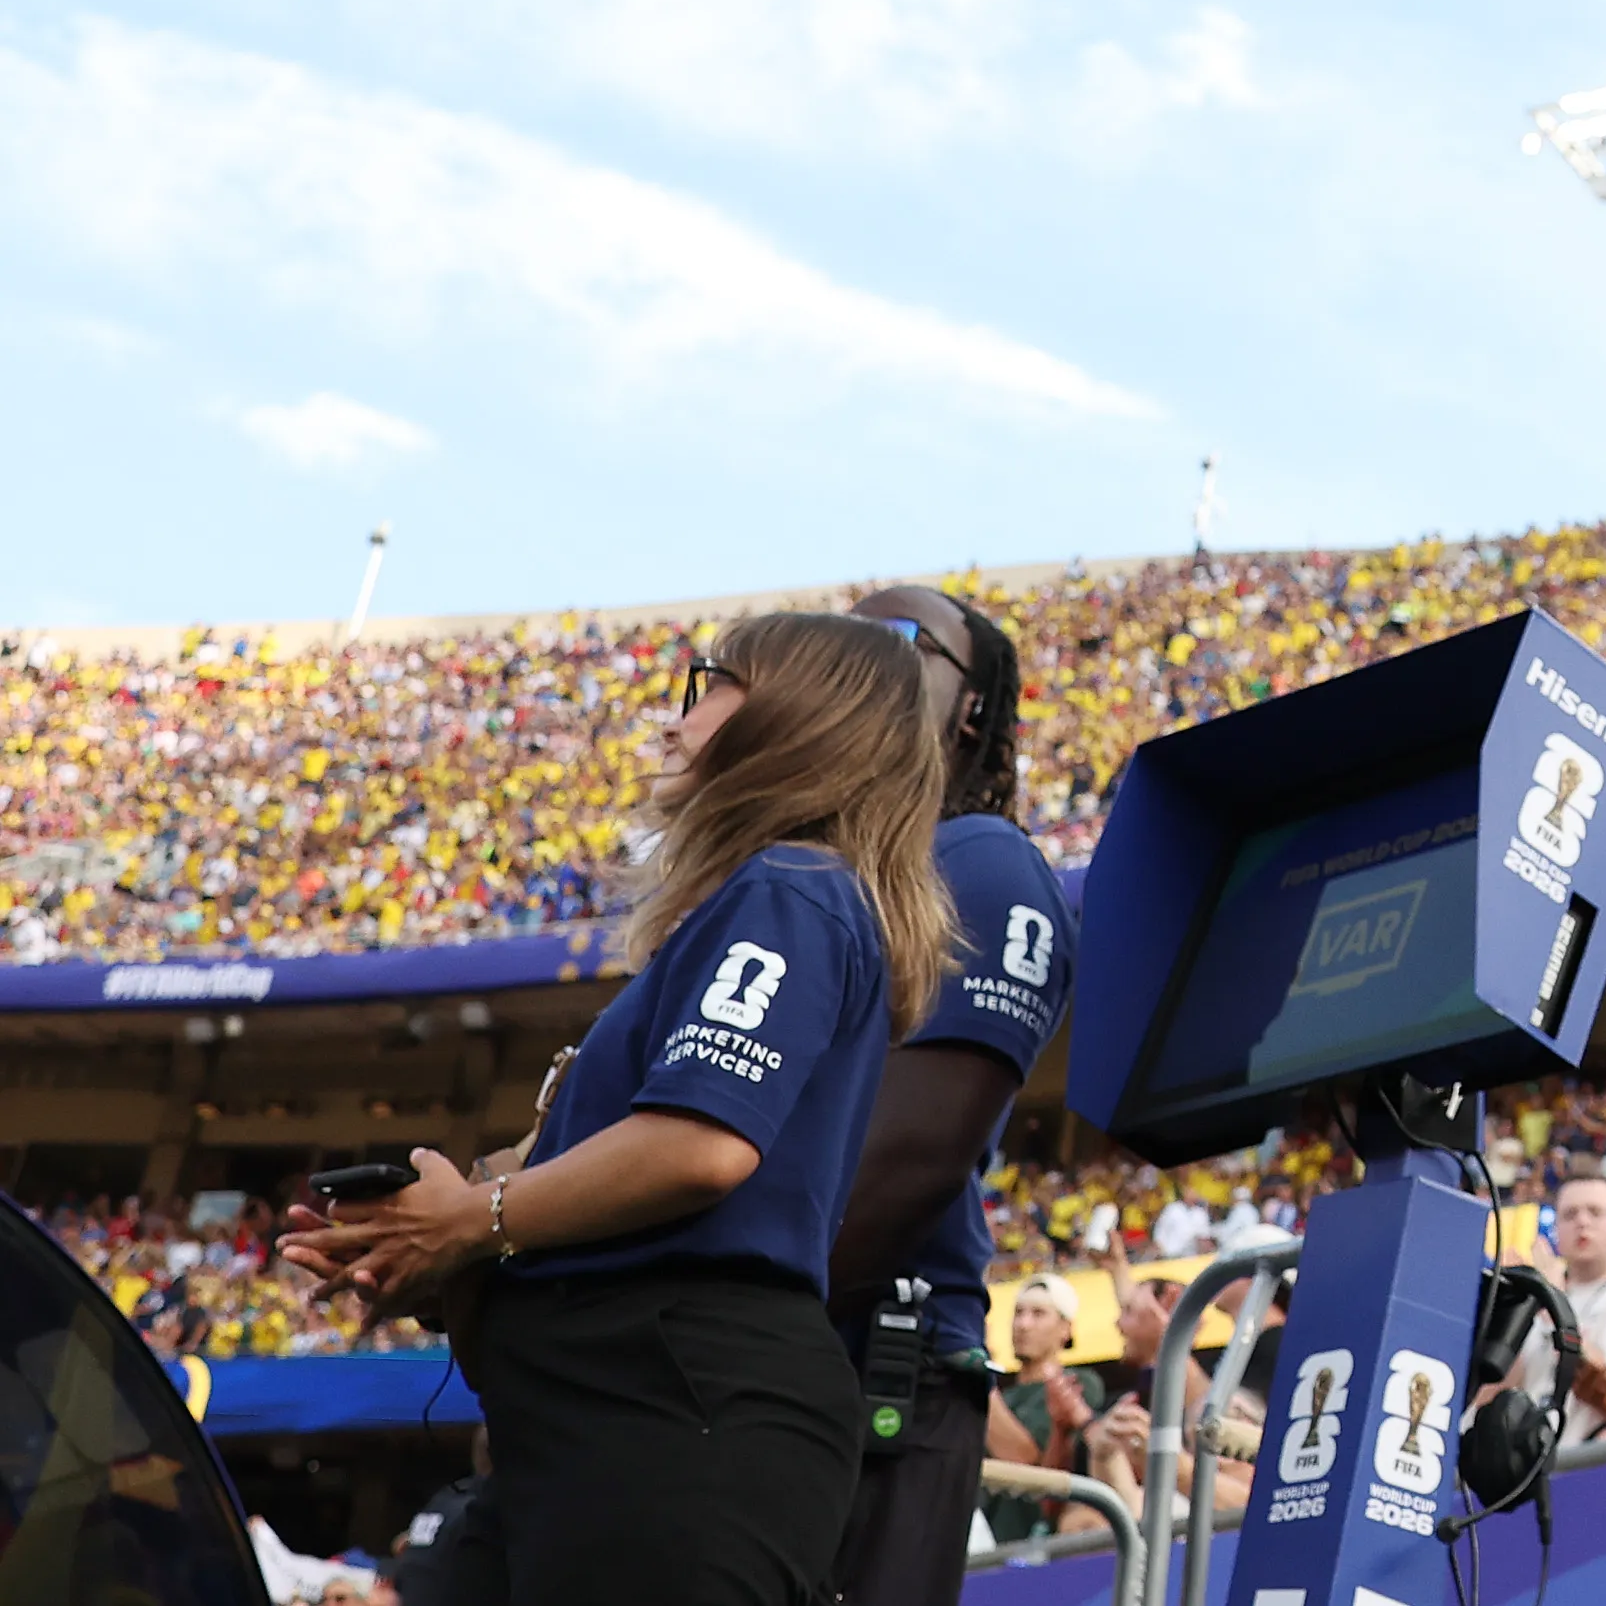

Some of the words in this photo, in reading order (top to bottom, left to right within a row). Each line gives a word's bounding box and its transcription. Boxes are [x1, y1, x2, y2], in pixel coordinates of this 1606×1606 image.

[1535, 824, 1563, 852] FIFA
[1503, 849, 1568, 904] 2026
[1319, 910, 1402, 966] VAR
[664, 1041, 764, 1083] SERVICES
[665, 1023, 783, 1070] MARKETING
[1295, 1453, 1320, 1469] FIFA
[1393, 1458, 1423, 1478] FIFA
[1273, 1485, 1307, 1502] WORLD
[1306, 1481, 1330, 1496] CUP
[1369, 1482, 1412, 1509] WORLD
[1412, 1492, 1438, 1514] CUP
[1267, 1496, 1326, 1524] 2026
[1364, 1498, 1436, 1537] 2026
